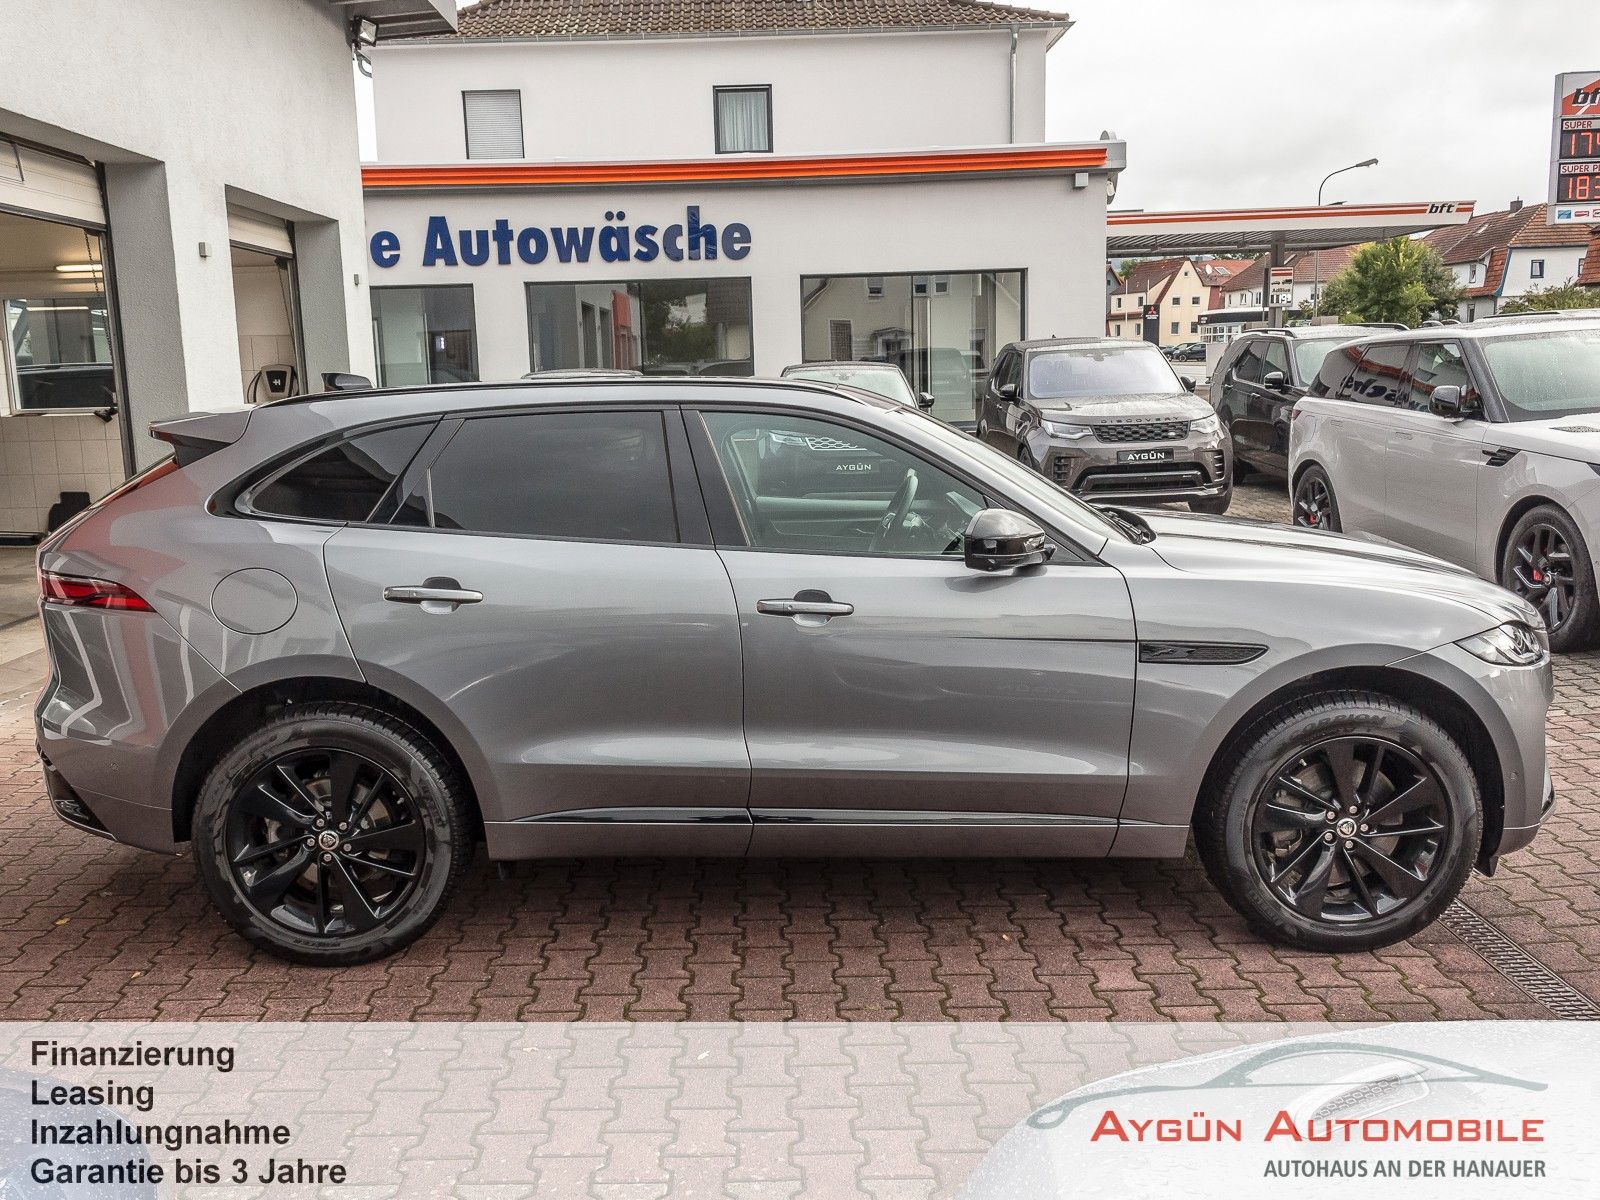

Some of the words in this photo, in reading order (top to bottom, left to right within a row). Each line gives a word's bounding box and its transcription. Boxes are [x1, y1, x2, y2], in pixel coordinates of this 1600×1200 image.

[1564, 121, 1592, 129] SUPER
[1570, 132, 1600, 156] 17
[1562, 164, 1589, 173] SUPER
[1429, 203, 1455, 213] bft
[369, 230, 401, 268] e
[422, 205, 752, 267] Autowäsche
[1101, 416, 1179, 424] DISCOVERY
[1127, 451, 1165, 461] AYGÜN
[836, 462, 872, 471] AYGÜN
